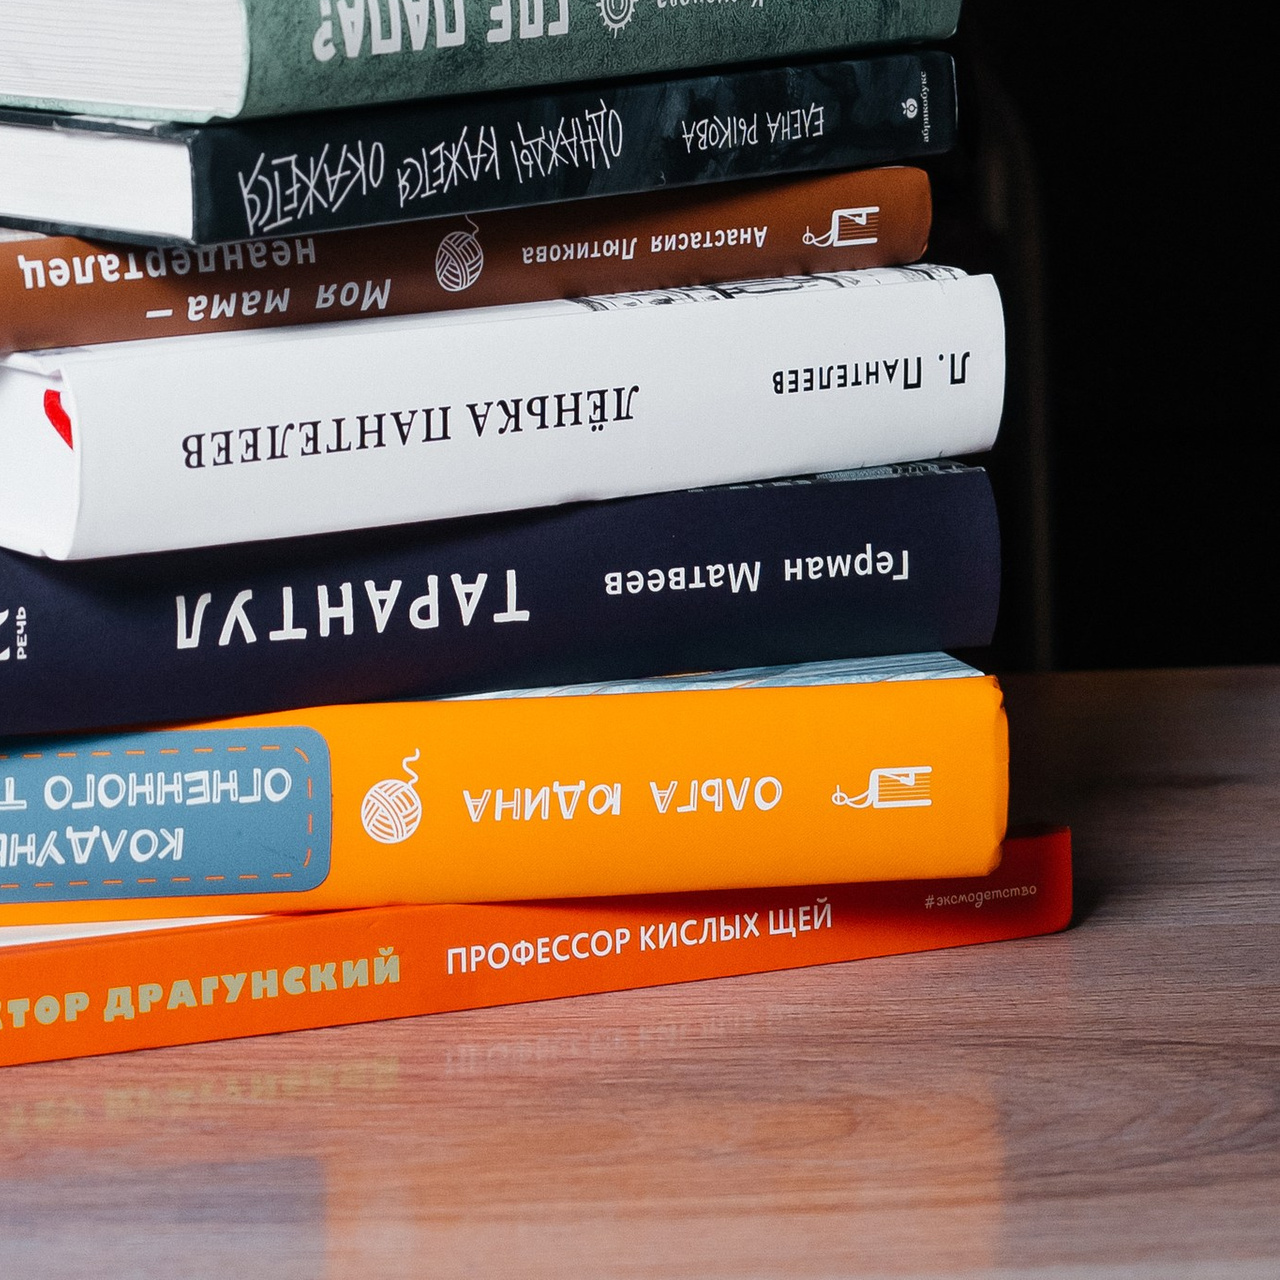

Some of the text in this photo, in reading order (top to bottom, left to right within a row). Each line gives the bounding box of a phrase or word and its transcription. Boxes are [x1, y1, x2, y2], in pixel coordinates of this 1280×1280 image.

[682, 103, 825, 153] ЕЛЕНА РЫКОВА
[920, 70, 931, 143] абрикобукс
[239, 99, 623, 236] ОДНАЖДЫ КАЖЕТСЯ ОКАЖЕТСЯ
[17, 239, 316, 290] неандерталец
[522, 226, 768, 265] Анастасия Лютикова
[187, 287, 290, 321] мама
[315, 278, 391, 310] Моя
[937, 351, 971, 385] Л.
[181, 385, 640, 469] ЛЁНЬКА ПАНТЕЛЕЕВ
[605, 543, 910, 595] Герман Матвеев
[175, 569, 530, 650] ТАРАНТУЛ
[44, 767, 293, 811] ОГНЕННОГО
[463, 776, 783, 822] ОЛЬГА ЮДИНА
[924, 885, 1037, 909] #эксмодетство
[446, 898, 833, 975] ПРОФЕССОР КИСЛЫХ ЩЕЙ
[103, 947, 402, 1023] ДРАГУНСКИЙ
